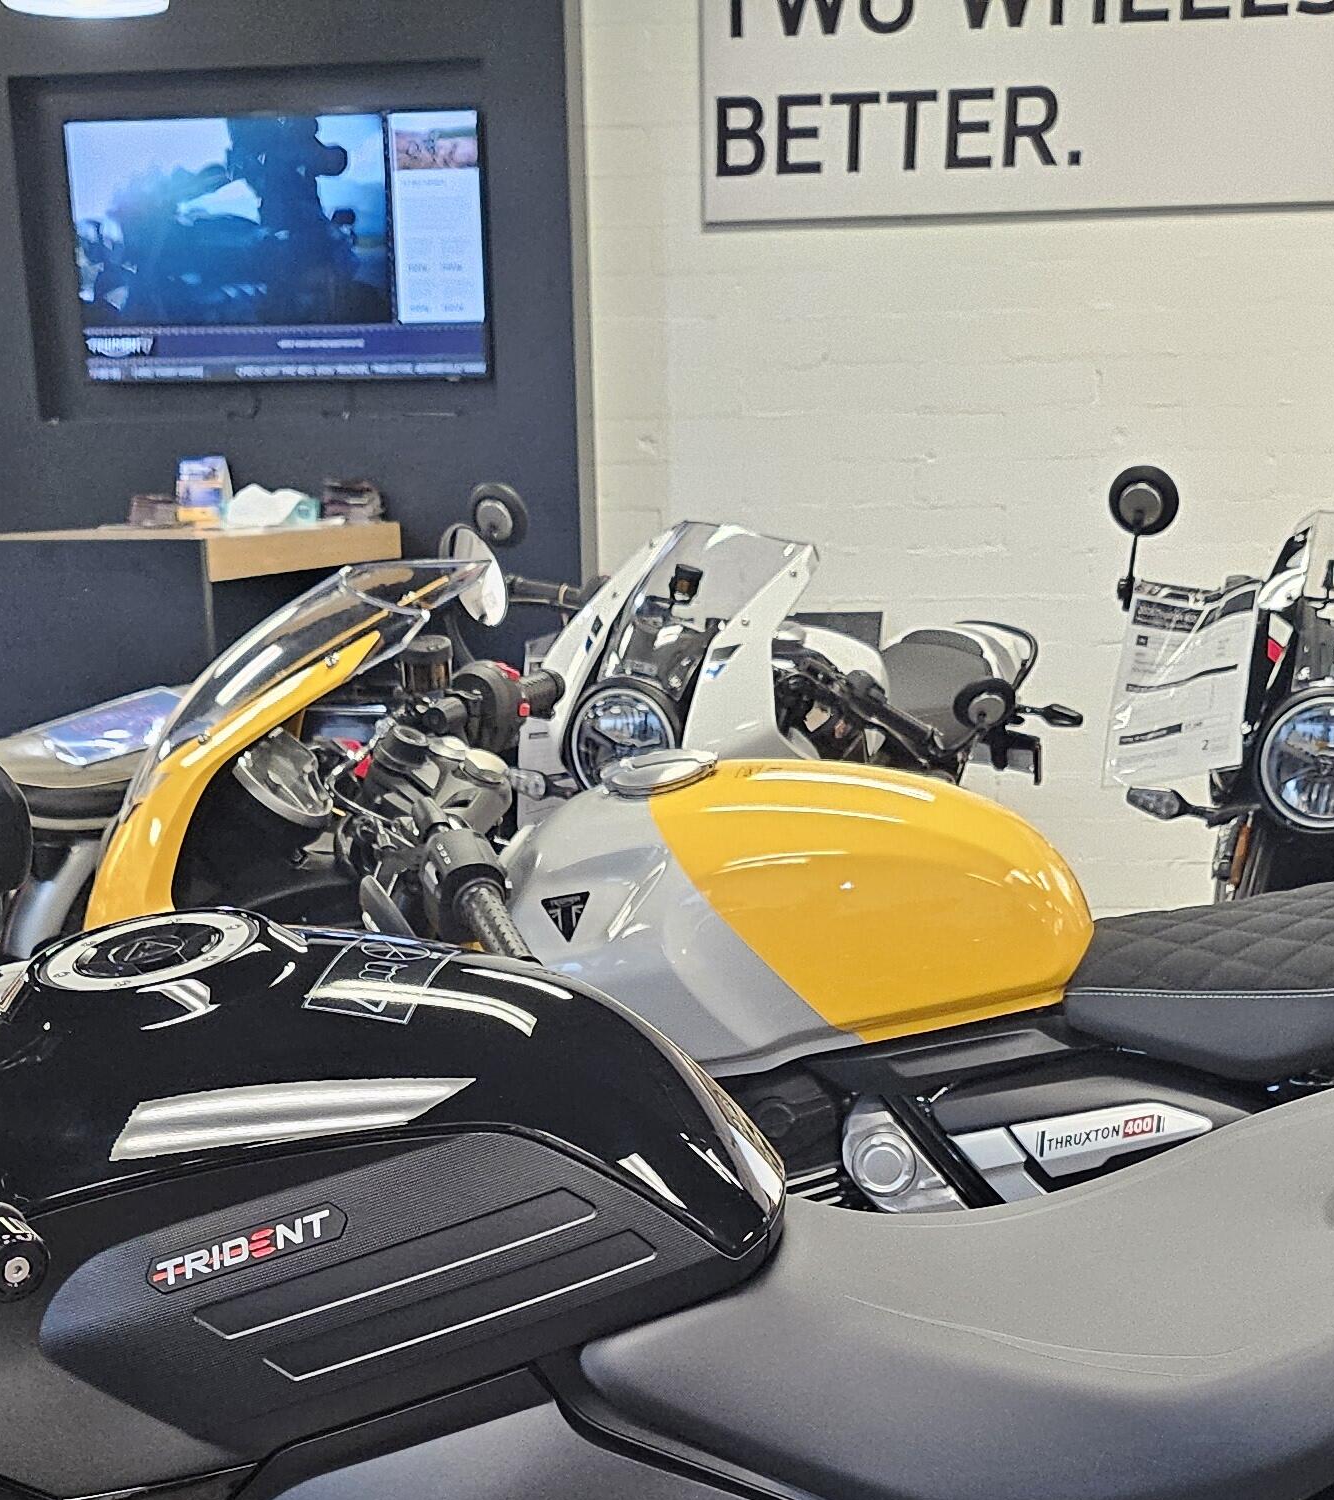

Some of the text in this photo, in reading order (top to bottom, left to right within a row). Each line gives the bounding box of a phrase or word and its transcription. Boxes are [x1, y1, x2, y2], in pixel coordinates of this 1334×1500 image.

[716, 85, 1082, 177] BETTER.
[1046, 1116, 1153, 1151] THRUXTON 400
[154, 1209, 330, 1286] TRIDENT
